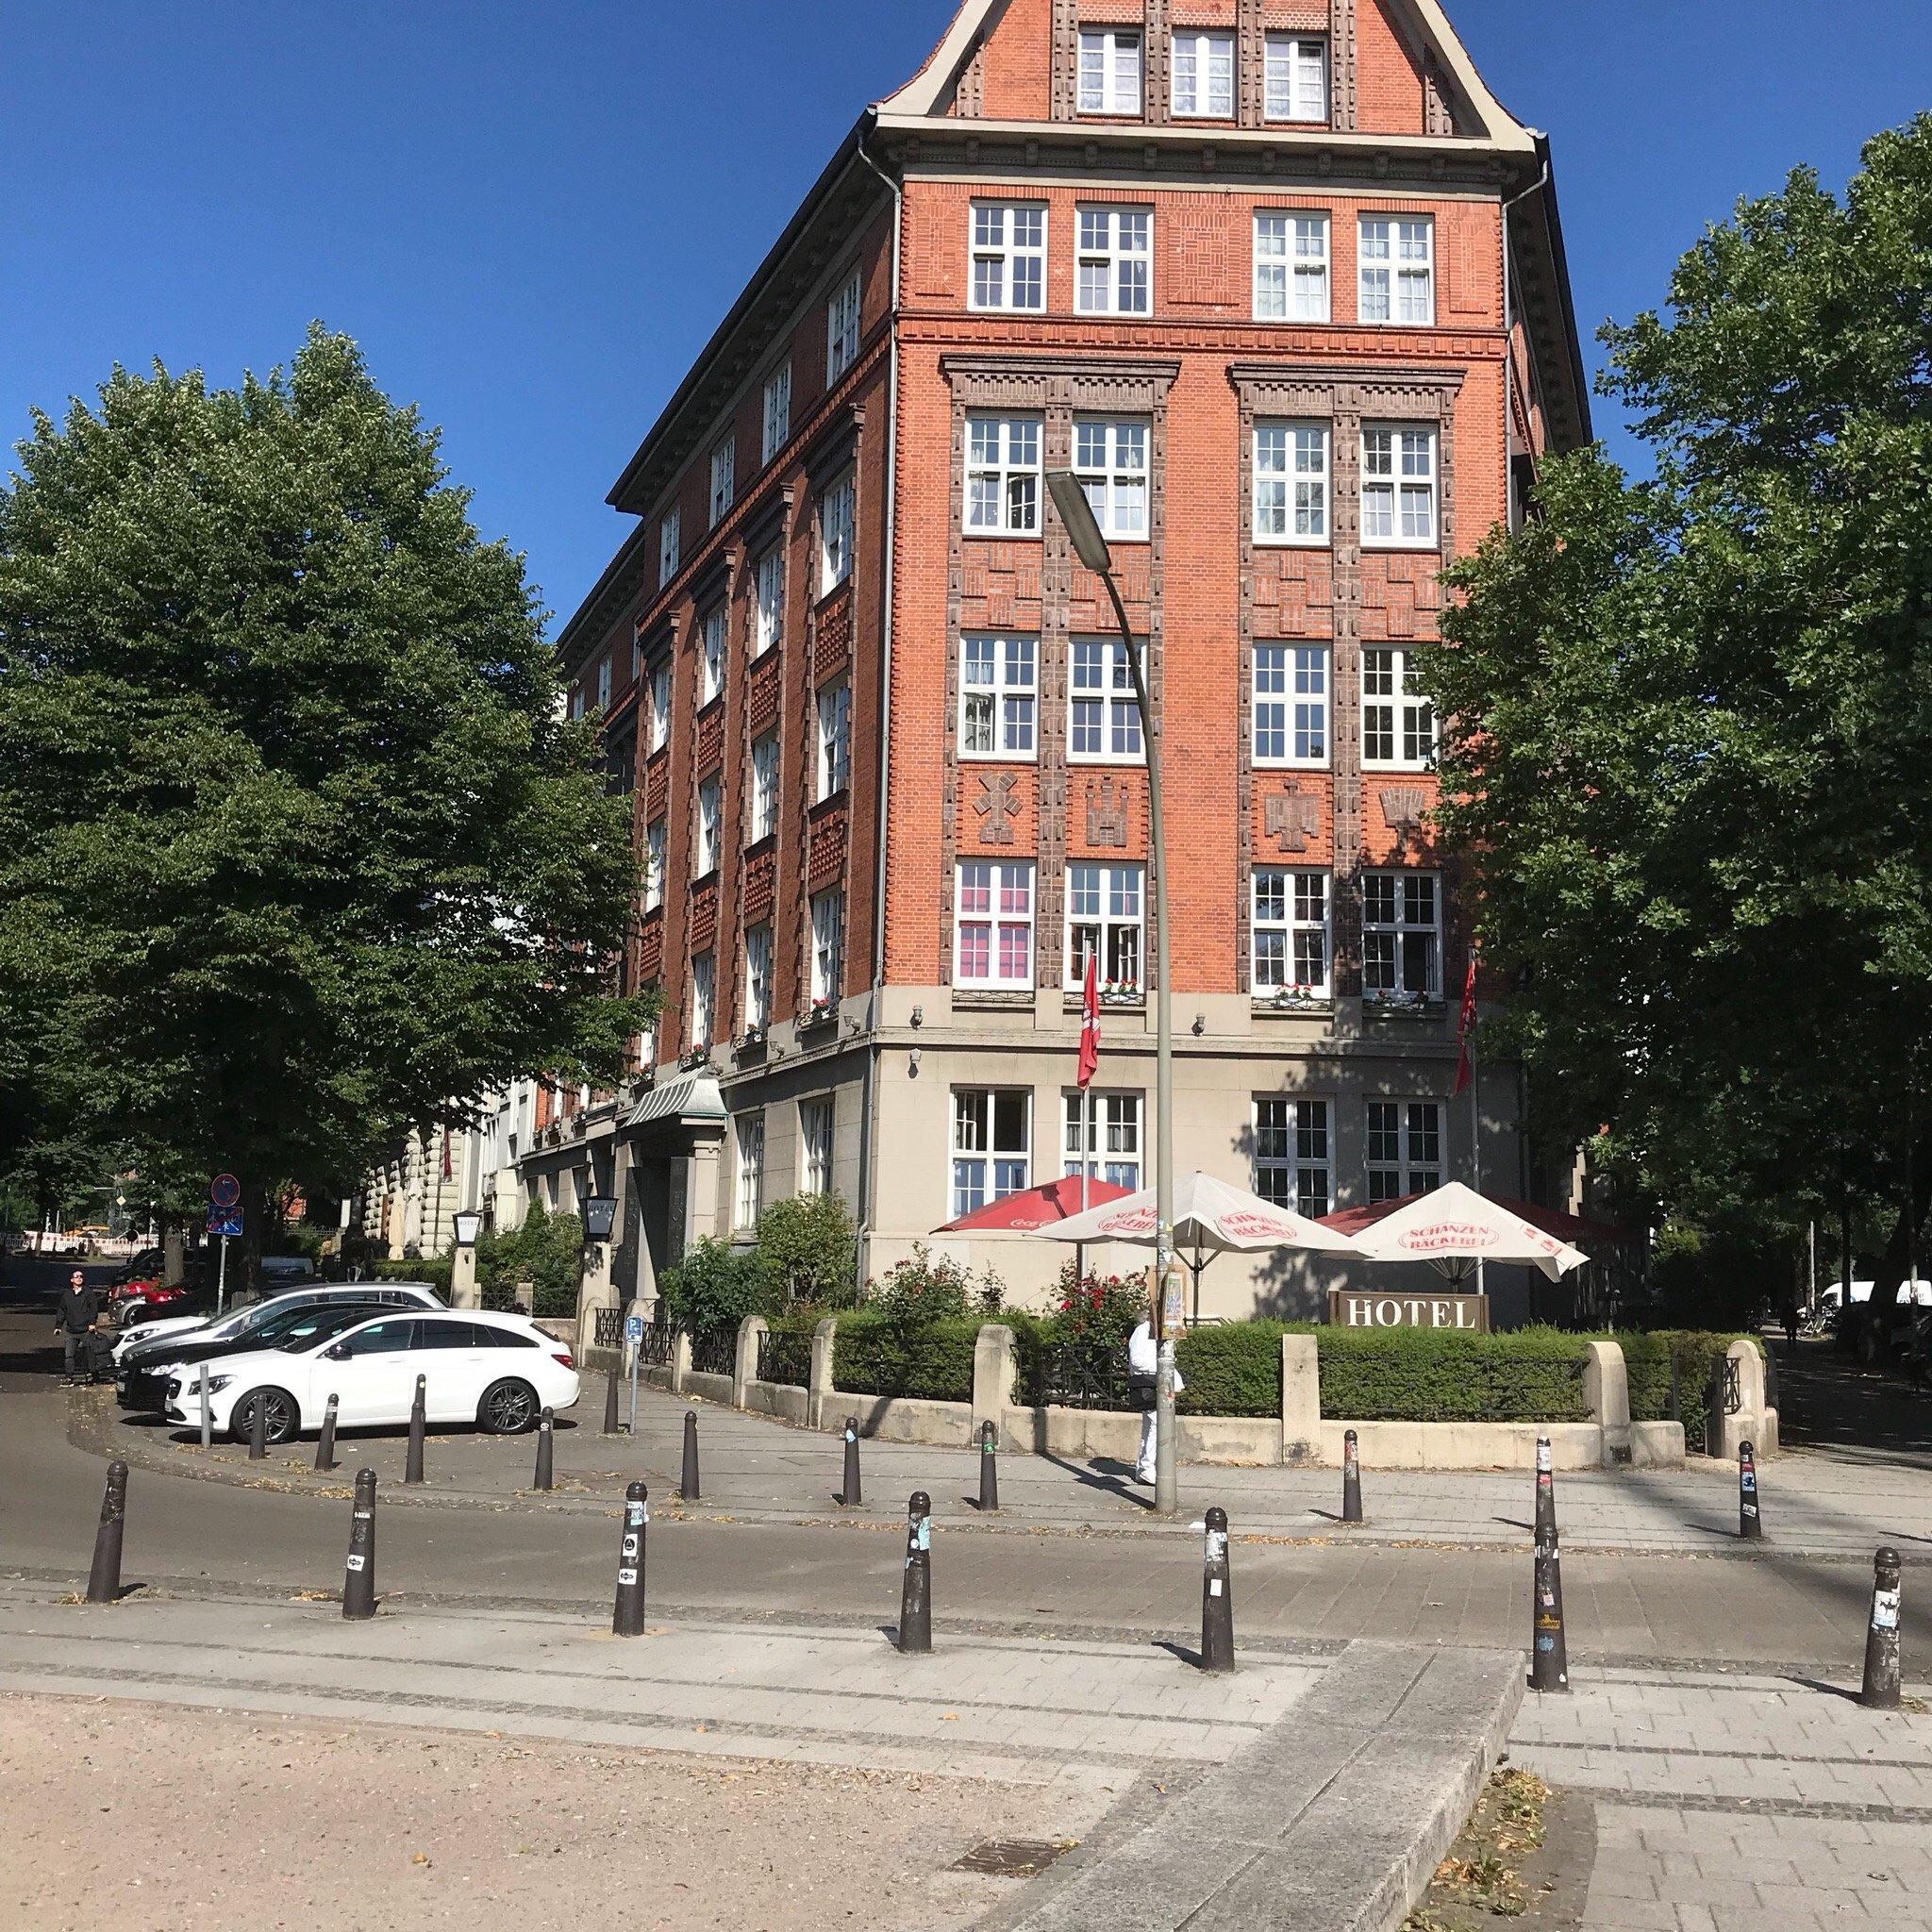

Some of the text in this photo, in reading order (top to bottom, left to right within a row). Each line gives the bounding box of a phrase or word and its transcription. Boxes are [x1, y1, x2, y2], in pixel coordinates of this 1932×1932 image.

[588, 1204, 612, 1212] HOTEL
[1409, 1224, 1490, 1238] SCHANZEN
[1409, 1237, 1486, 1250] BÄCKEREI
[1346, 1298, 1476, 1329] HOTEL
